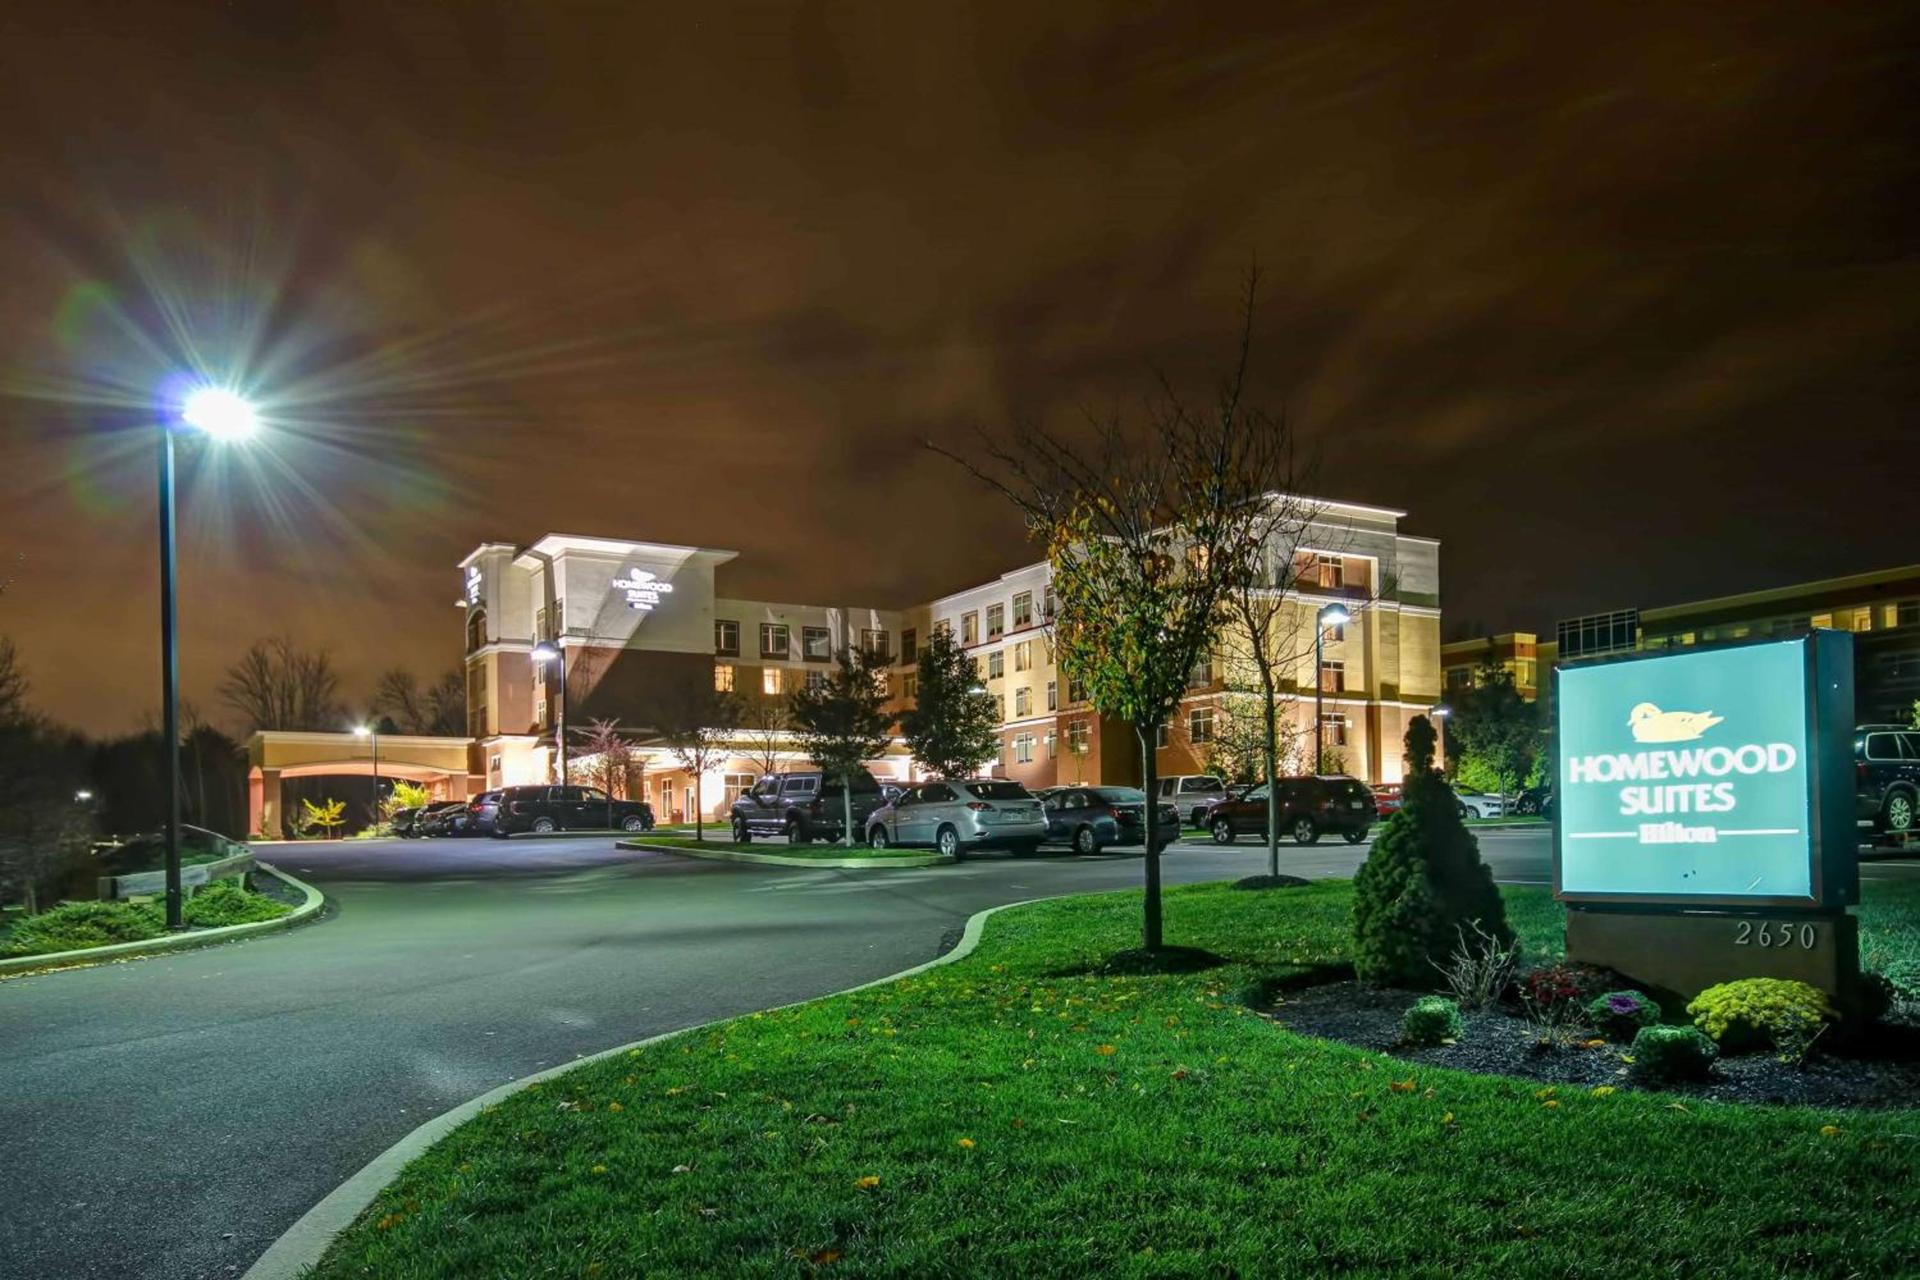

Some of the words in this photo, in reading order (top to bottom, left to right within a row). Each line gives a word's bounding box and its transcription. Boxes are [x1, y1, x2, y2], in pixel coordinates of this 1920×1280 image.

[1569, 743, 1797, 784] HOMEWOOD
[1619, 782, 1737, 816] SUITES
[1734, 920, 1815, 949] 2650
